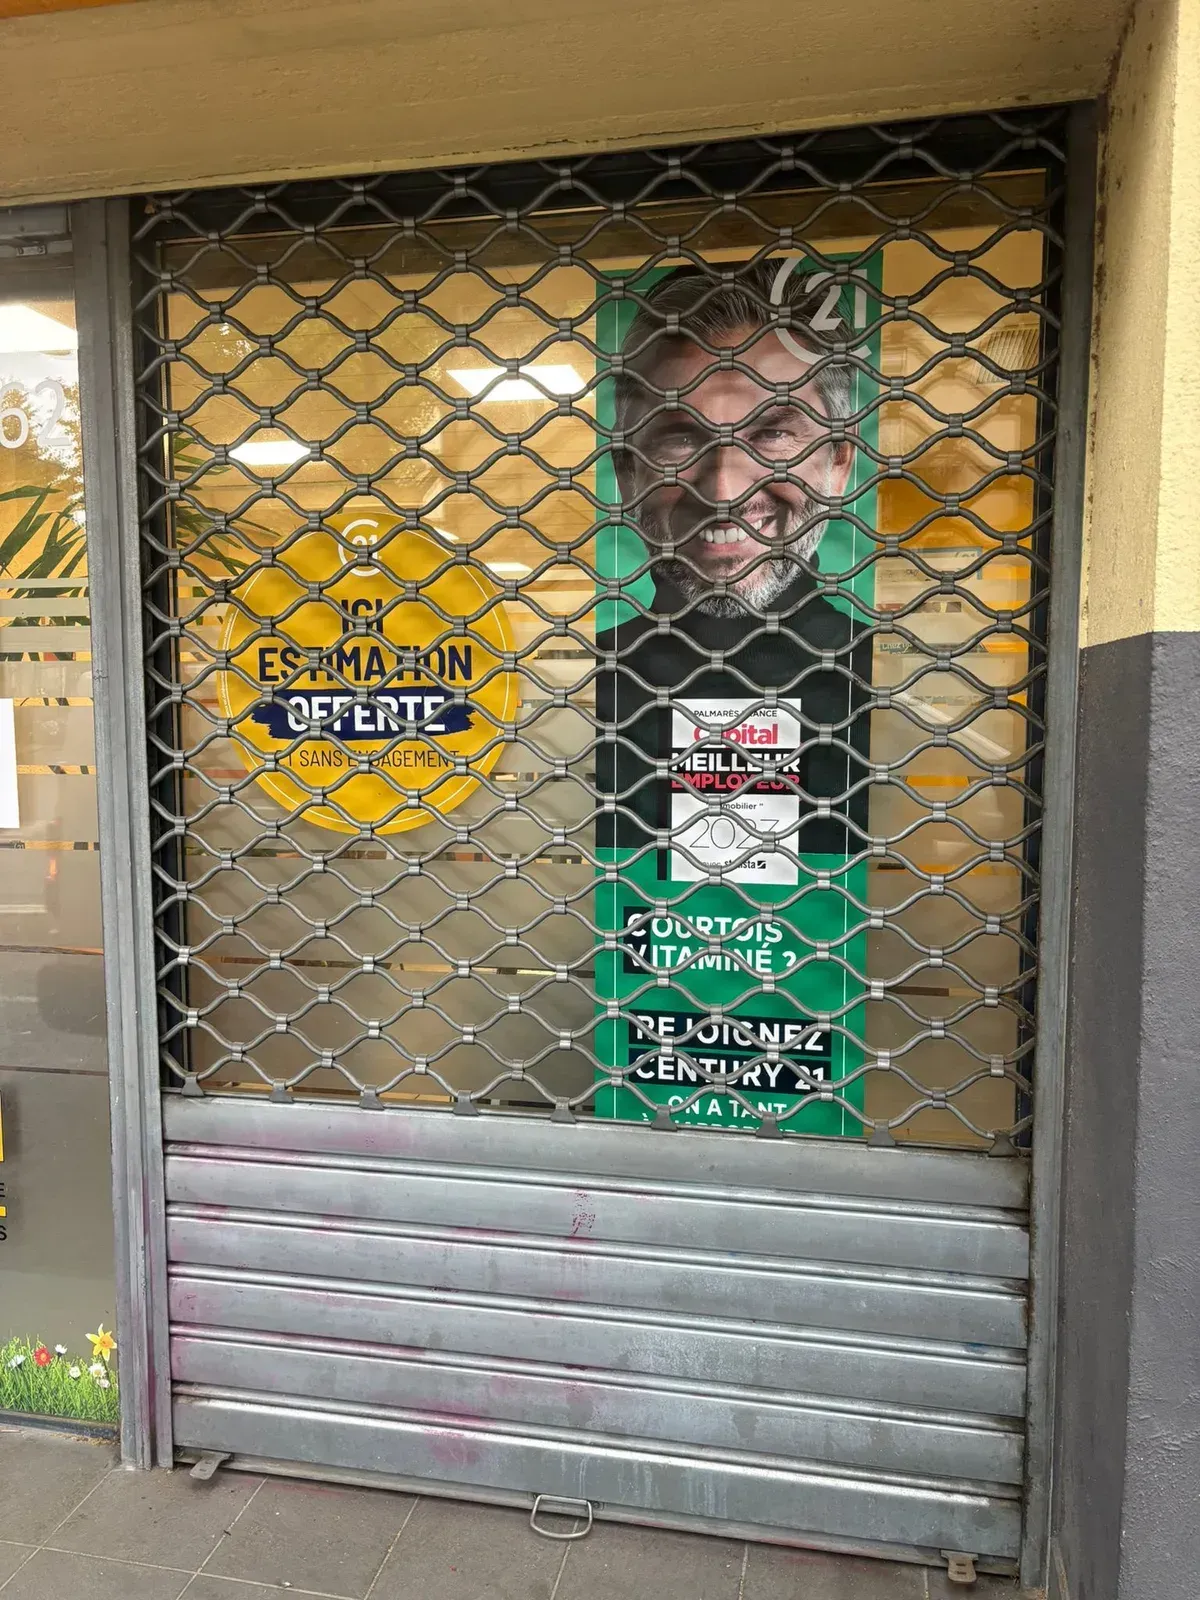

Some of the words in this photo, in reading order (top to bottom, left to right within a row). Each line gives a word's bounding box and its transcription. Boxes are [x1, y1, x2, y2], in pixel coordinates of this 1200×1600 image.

[341, 598, 384, 635] ICI
[287, 695, 446, 732] OFFERTE
[693, 708, 740, 718] PALMARÈS
[741, 709, 778, 718] ANCE
[693, 723, 779, 749] Cpital
[299, 749, 343, 768] SANS
[724, 859, 756, 869] stista
[627, 913, 783, 943] COURTOIS
[627, 942, 773, 973] VITAMINÉ
[635, 1053, 784, 1088] CENTURY
[794, 1065, 825, 1092] 21
[668, 1095, 700, 1115] ON
[706, 1099, 723, 1117] A
